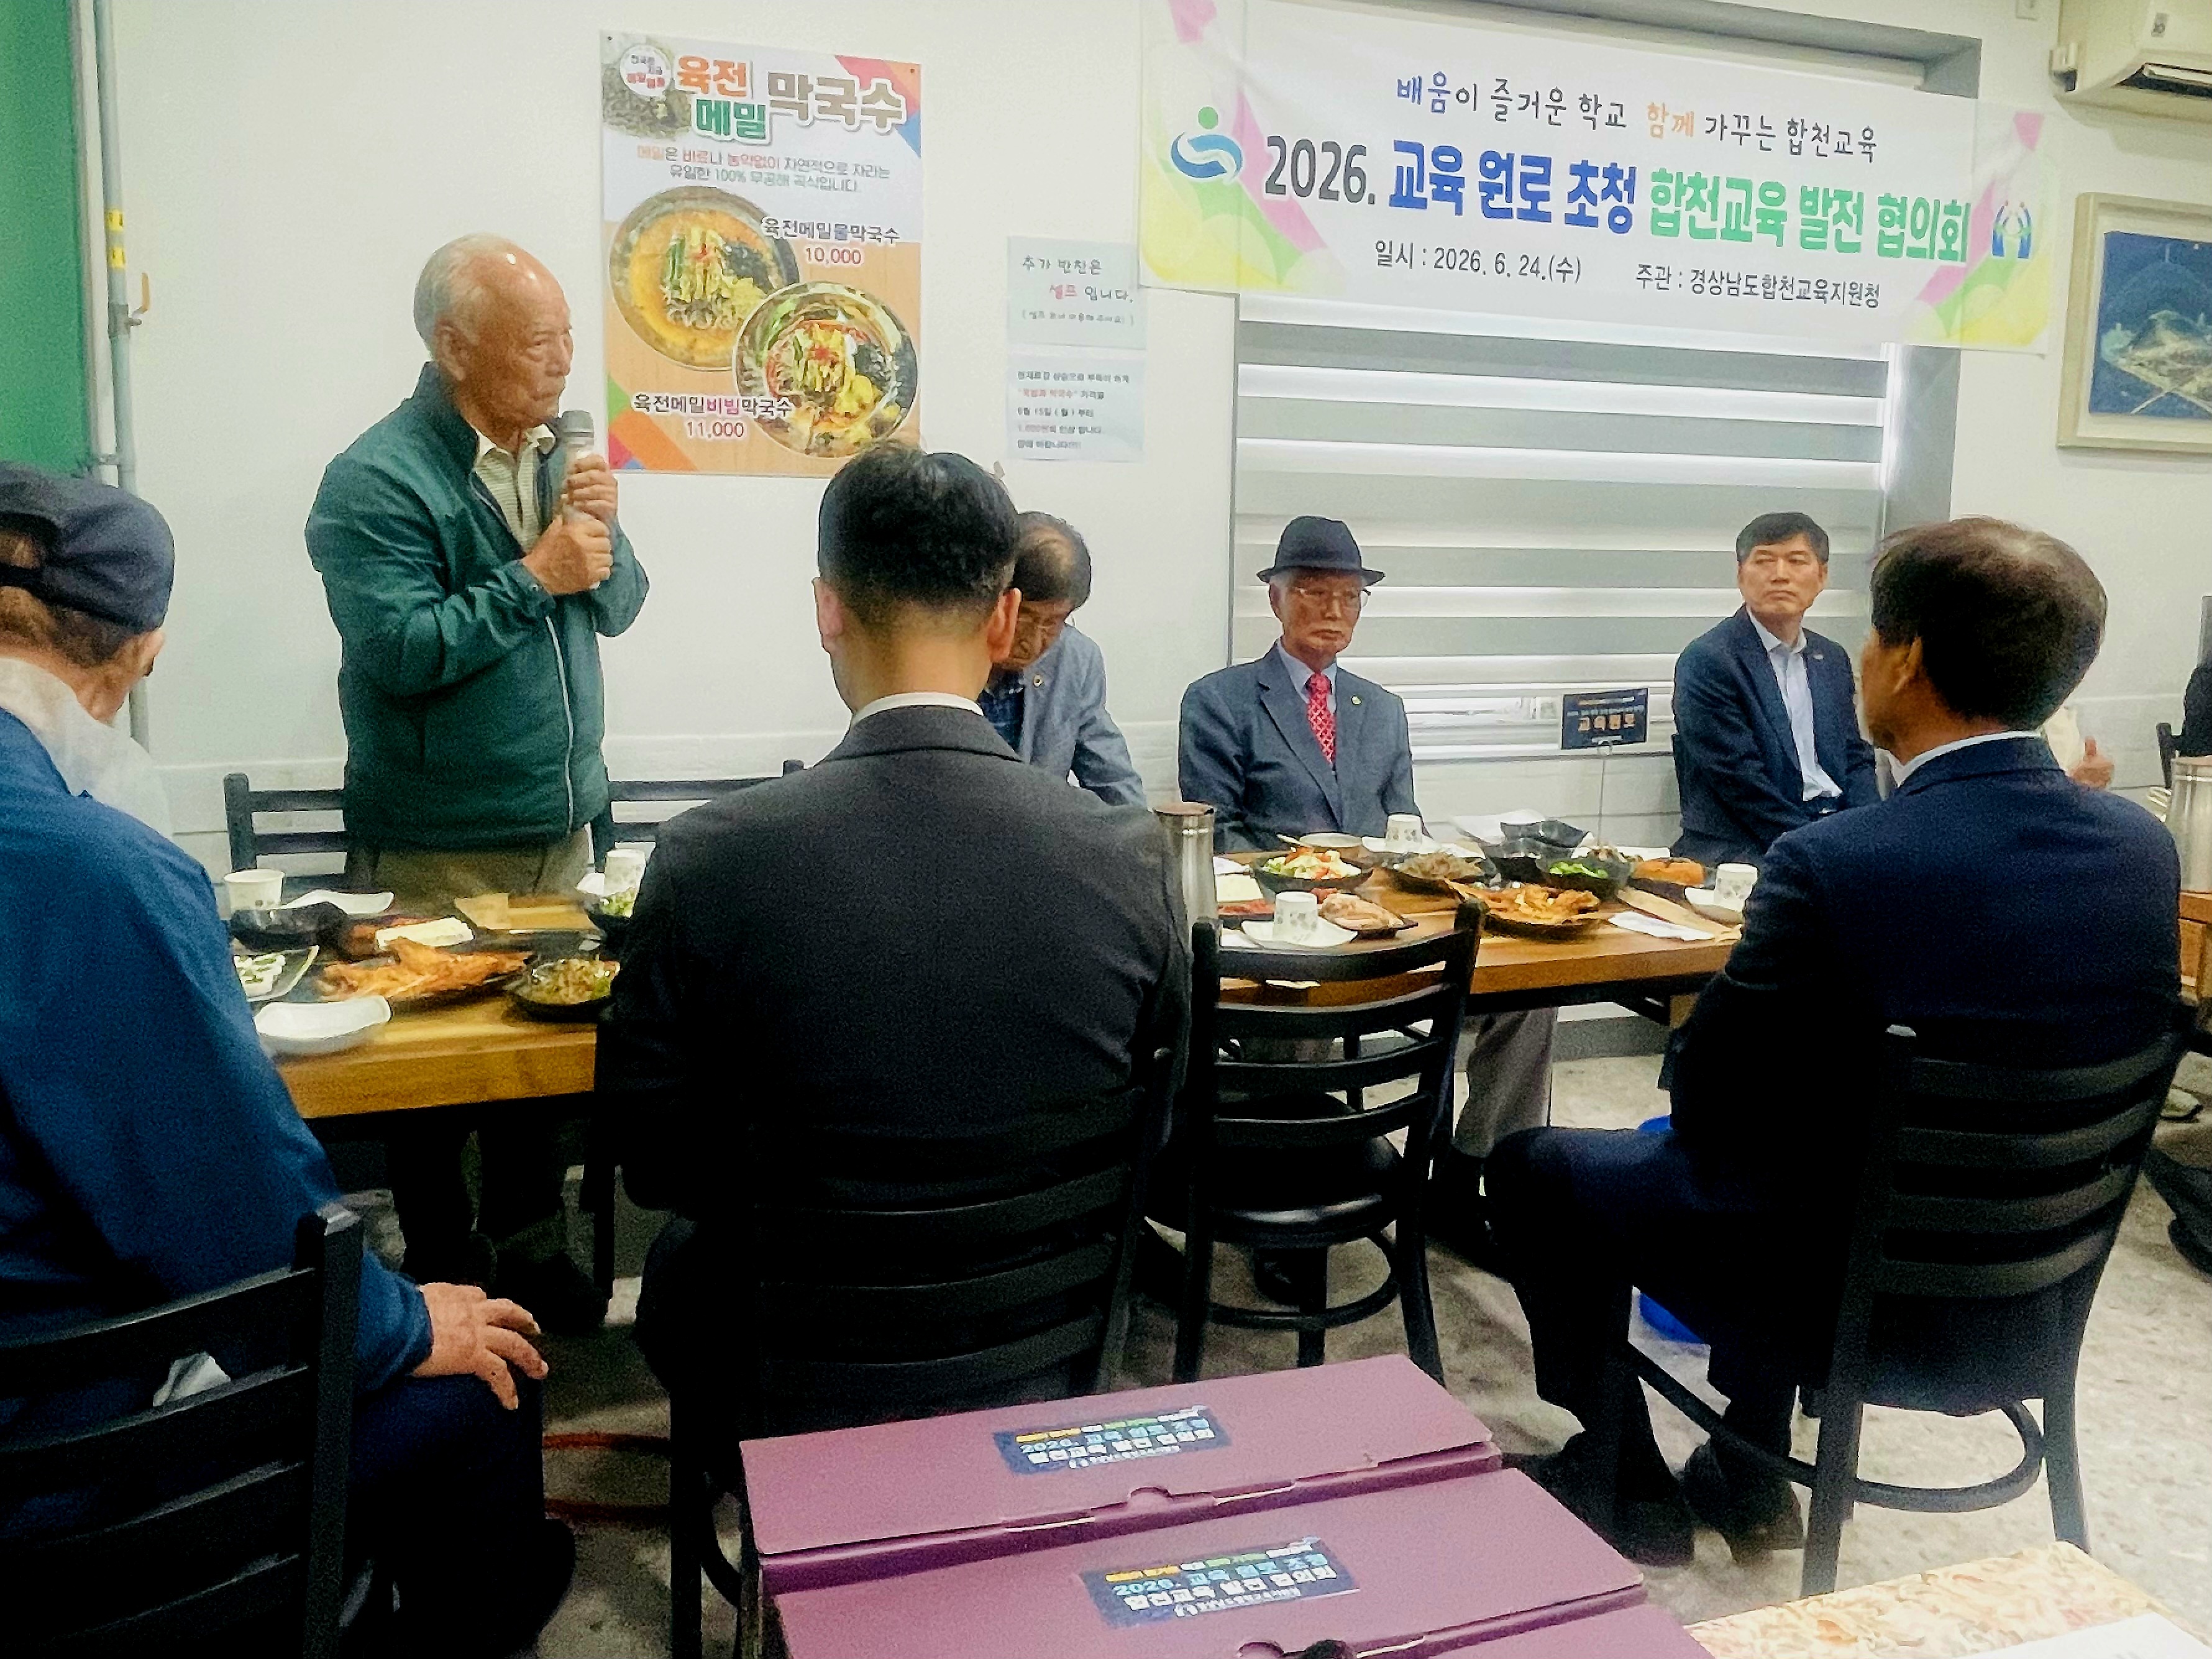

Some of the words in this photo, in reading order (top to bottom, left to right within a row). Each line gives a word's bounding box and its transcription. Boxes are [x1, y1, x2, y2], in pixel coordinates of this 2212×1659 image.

[677, 54, 746, 96] 육전
[767, 70, 903, 127] 막국수
[695, 98, 767, 140] 메밀
[1397, 71, 1478, 114] 배움이
[1491, 78, 1566, 127] 즐거운
[1579, 93, 1627, 130] 학교
[1647, 101, 1695, 139] 함께
[1704, 114, 1776, 152] 가꾸는
[1787, 117, 1878, 163] 합천교육
[715, 168, 746, 183] 100%
[852, 162, 890, 179] 자라는
[1264, 135, 1376, 205] 2026.
[1389, 140, 1465, 216] 교육
[1478, 150, 1552, 224] 원로
[1564, 159, 1637, 235] 초청
[1649, 167, 1788, 249] 합천교육
[1799, 185, 1865, 254] 발전
[1876, 191, 1972, 263] 협의회
[764, 217, 900, 244] 육전메밀물막국수
[807, 246, 862, 266] 10,000
[1022, 255, 1051, 271] 추가
[1058, 258, 1102, 276] 반찬은
[1374, 240, 1414, 270] 일시
[1433, 247, 1488, 276] 2026.
[1494, 252, 1511, 278] 6.
[1084, 285, 1133, 303] 입니다.
[1635, 263, 1671, 291] 주관
[1689, 268, 1881, 309] 경상남도합천교육지원청
[633, 393, 793, 416] 육전메밀비빔막국수
[687, 421, 744, 439] 11,000
